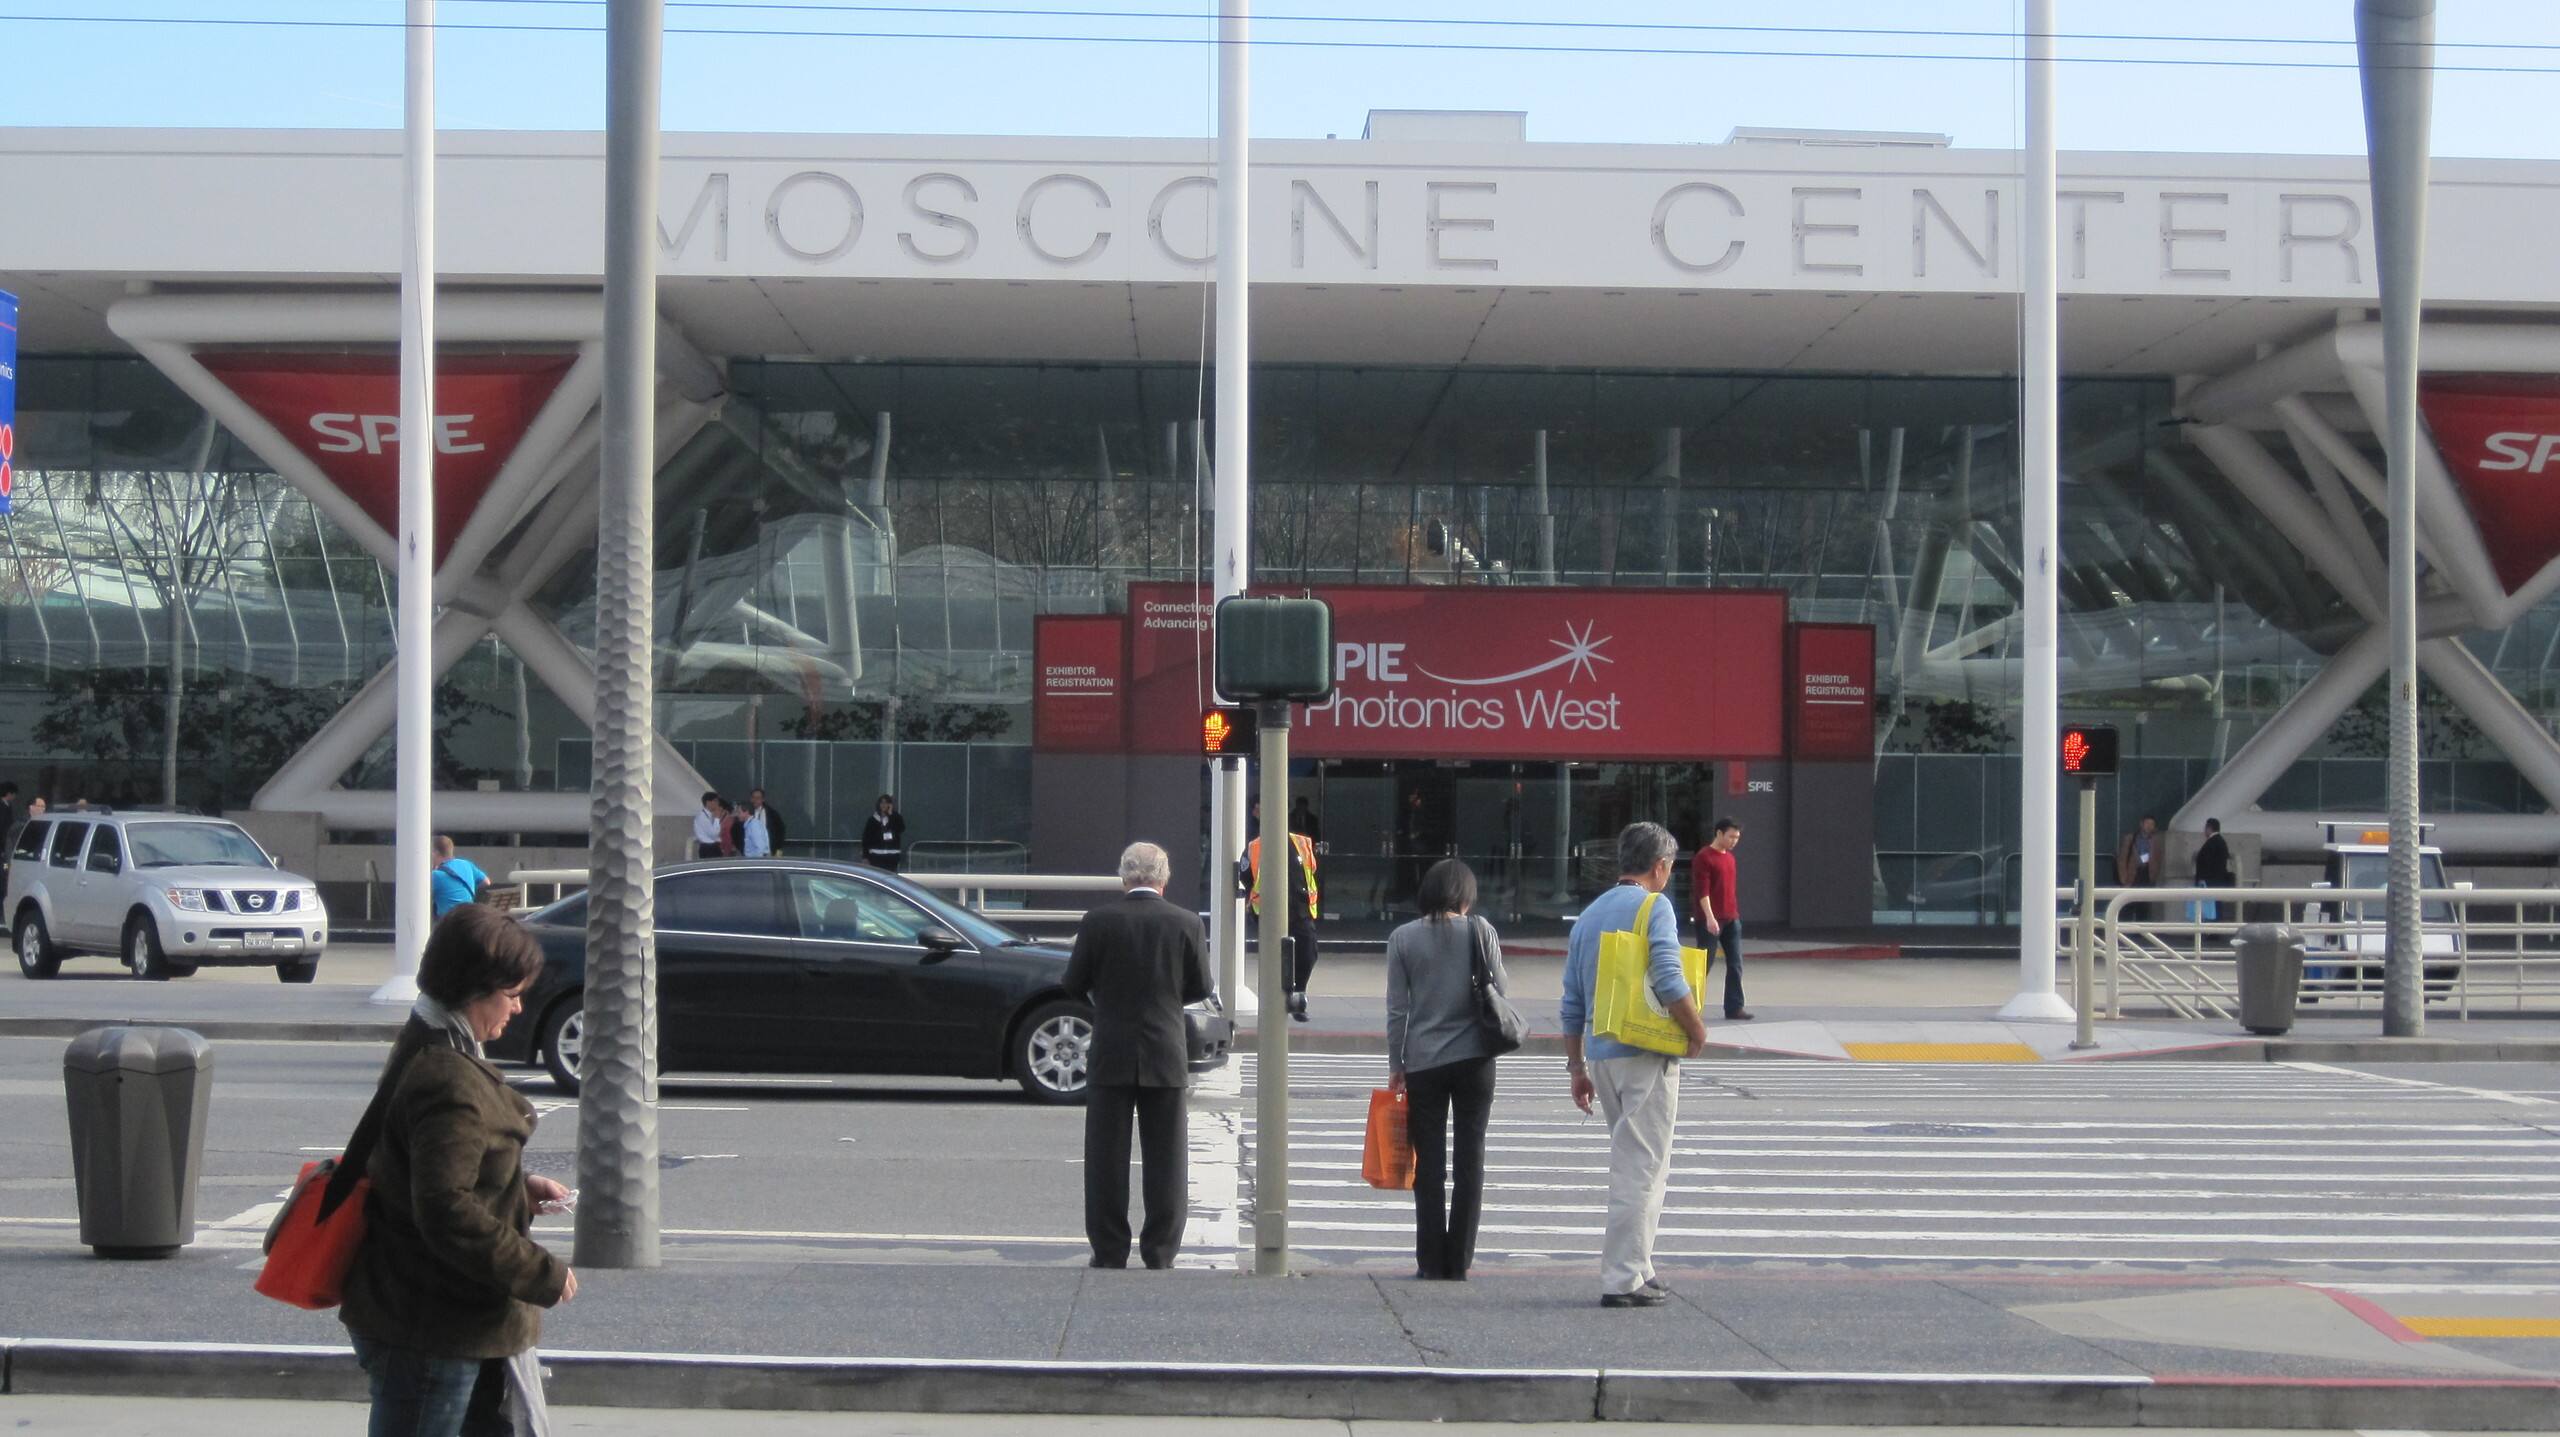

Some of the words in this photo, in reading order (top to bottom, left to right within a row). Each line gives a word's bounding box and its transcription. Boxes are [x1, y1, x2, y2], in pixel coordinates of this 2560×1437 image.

[656, 171, 1499, 272] MOSCONE
[1650, 182, 2362, 284] CENTER
[309, 412, 485, 455] SPE
[1143, 601, 1214, 616] Connectng
[1143, 617, 1208, 632] Advancing
[1336, 642, 1408, 682] PIE
[1045, 666, 1096, 676] EXHIBITOR
[1045, 678, 1114, 688] REGISTRATION
[1806, 674, 1849, 684] EXHIBITOR
[1806, 686, 1865, 696] REGISTRATION
[1515, 688, 1621, 730] West
[1747, 781, 1774, 793] SPIE
